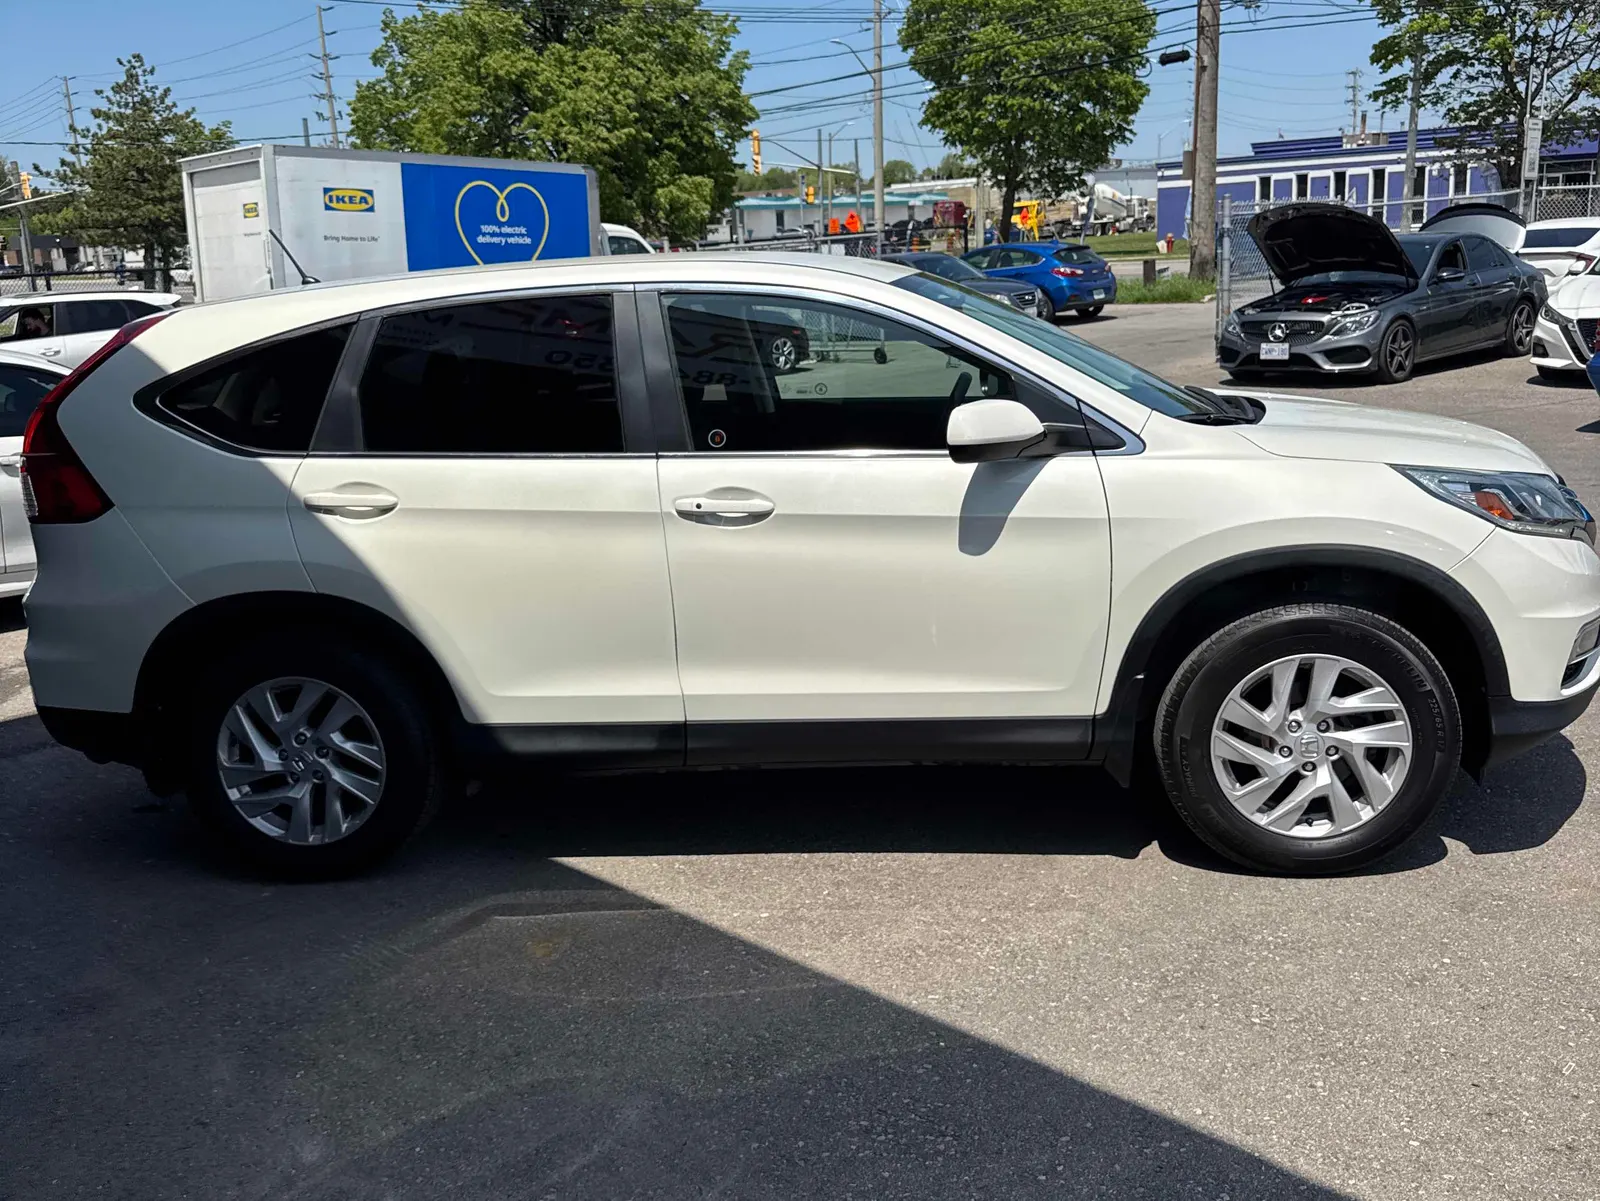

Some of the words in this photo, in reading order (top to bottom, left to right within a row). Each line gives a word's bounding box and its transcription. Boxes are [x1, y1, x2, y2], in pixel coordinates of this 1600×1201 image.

[328, 194, 369, 206] IKEA
[480, 225, 500, 234] 100%
[500, 226, 528, 235] electric
[323, 235, 340, 243] Bring
[476, 235, 505, 246] delivery
[506, 236, 532, 245] vehicle
